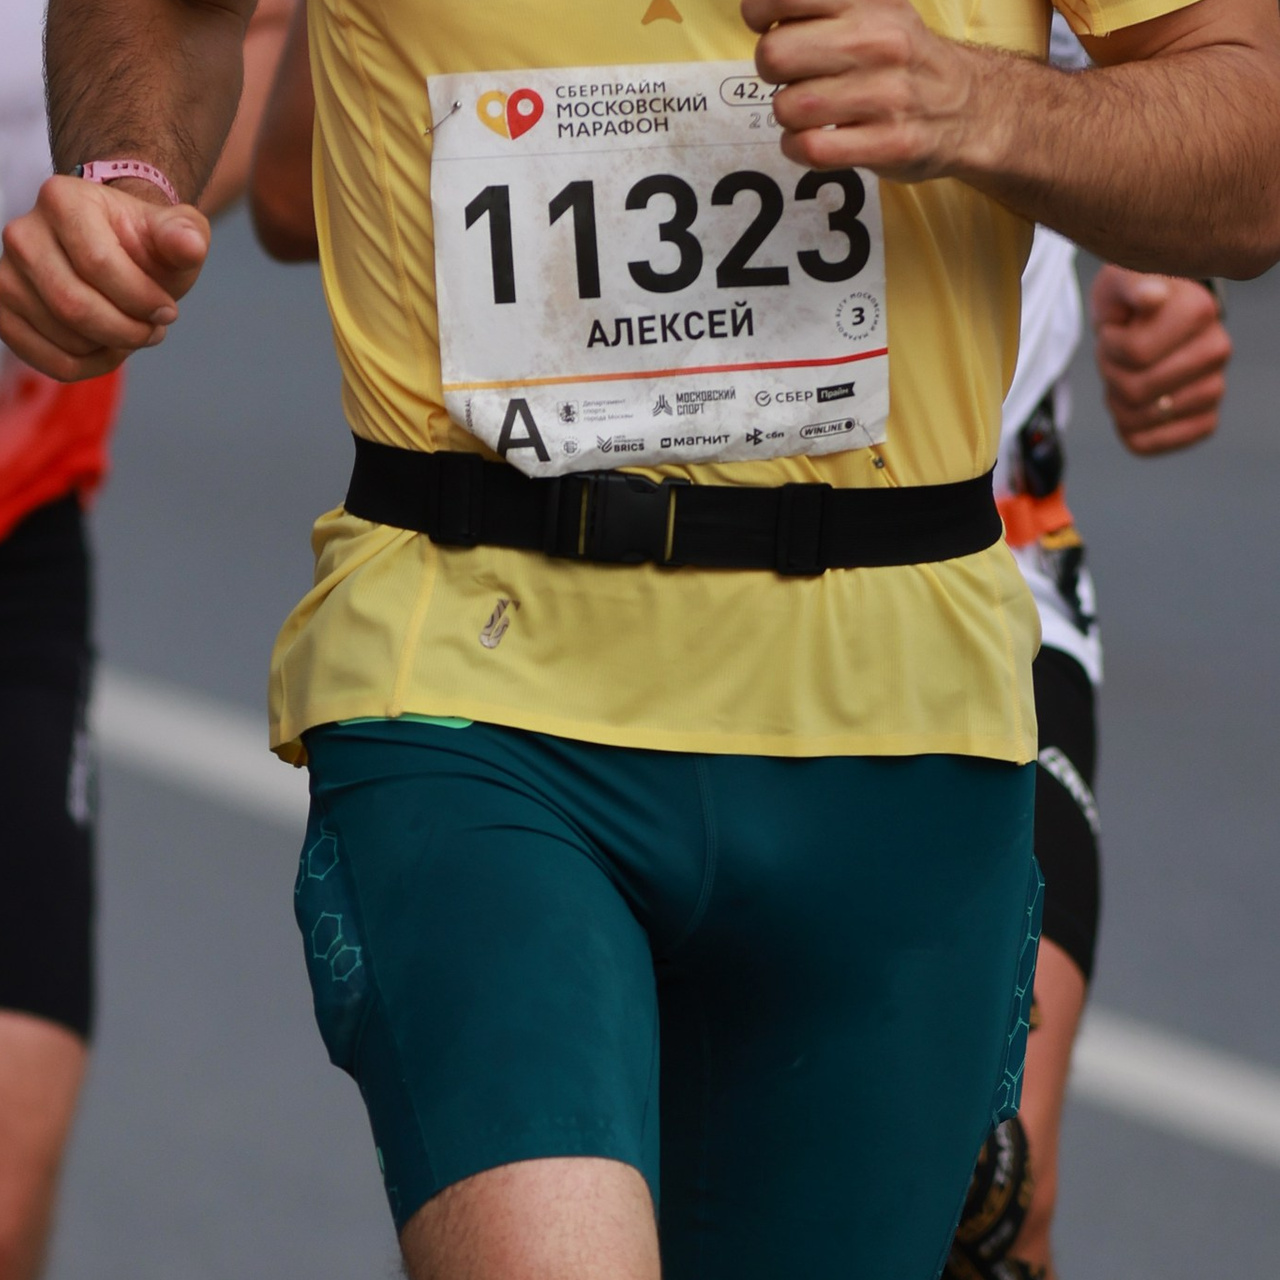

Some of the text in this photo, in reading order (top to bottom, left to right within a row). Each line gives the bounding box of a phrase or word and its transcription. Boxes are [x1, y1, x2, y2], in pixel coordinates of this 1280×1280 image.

[556, 81, 666, 98] СБЕРПРАЙМ
[557, 93, 708, 118] МОСКОВСКИЙ
[558, 117, 669, 138] МАРАФОН
[465, 167, 871, 304] 11323
[587, 301, 754, 348] АЛЕКСЕЙ
[852, 306, 865, 326] 3
[676, 386, 736, 403] МОСКОВСКИЙ
[775, 391, 813, 404] СБЕР
[676, 403, 705, 416] СПОРТ
[805, 423, 843, 436] WINLINE
[613, 443, 645, 452] BRICS
[673, 434, 731, 447] магнит
